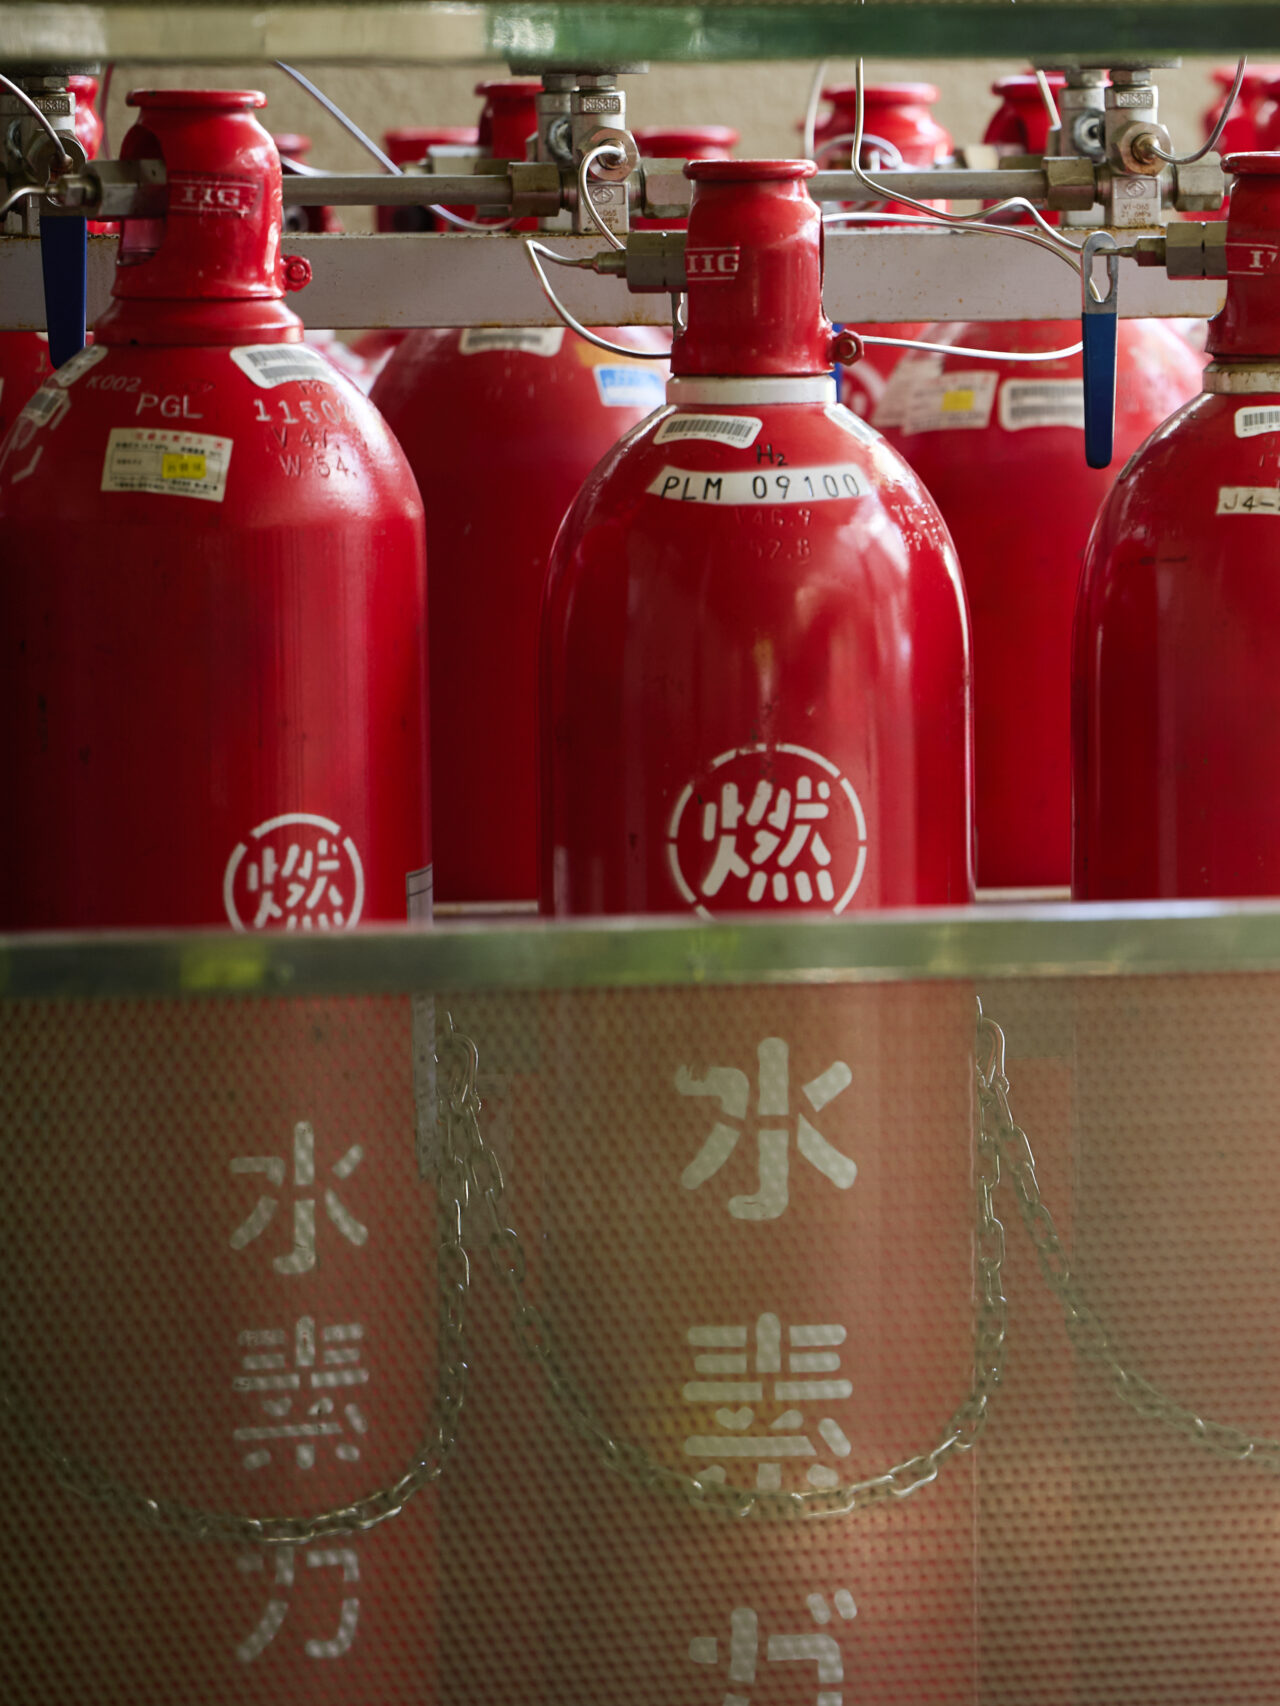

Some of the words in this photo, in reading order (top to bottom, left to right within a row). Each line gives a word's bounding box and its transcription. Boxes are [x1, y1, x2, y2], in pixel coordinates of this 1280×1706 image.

[135, 394, 203, 419] PGL
[660, 475, 724, 501] PLM
[751, 473, 861, 500] 09100
[702, 775, 835, 904] 燃
